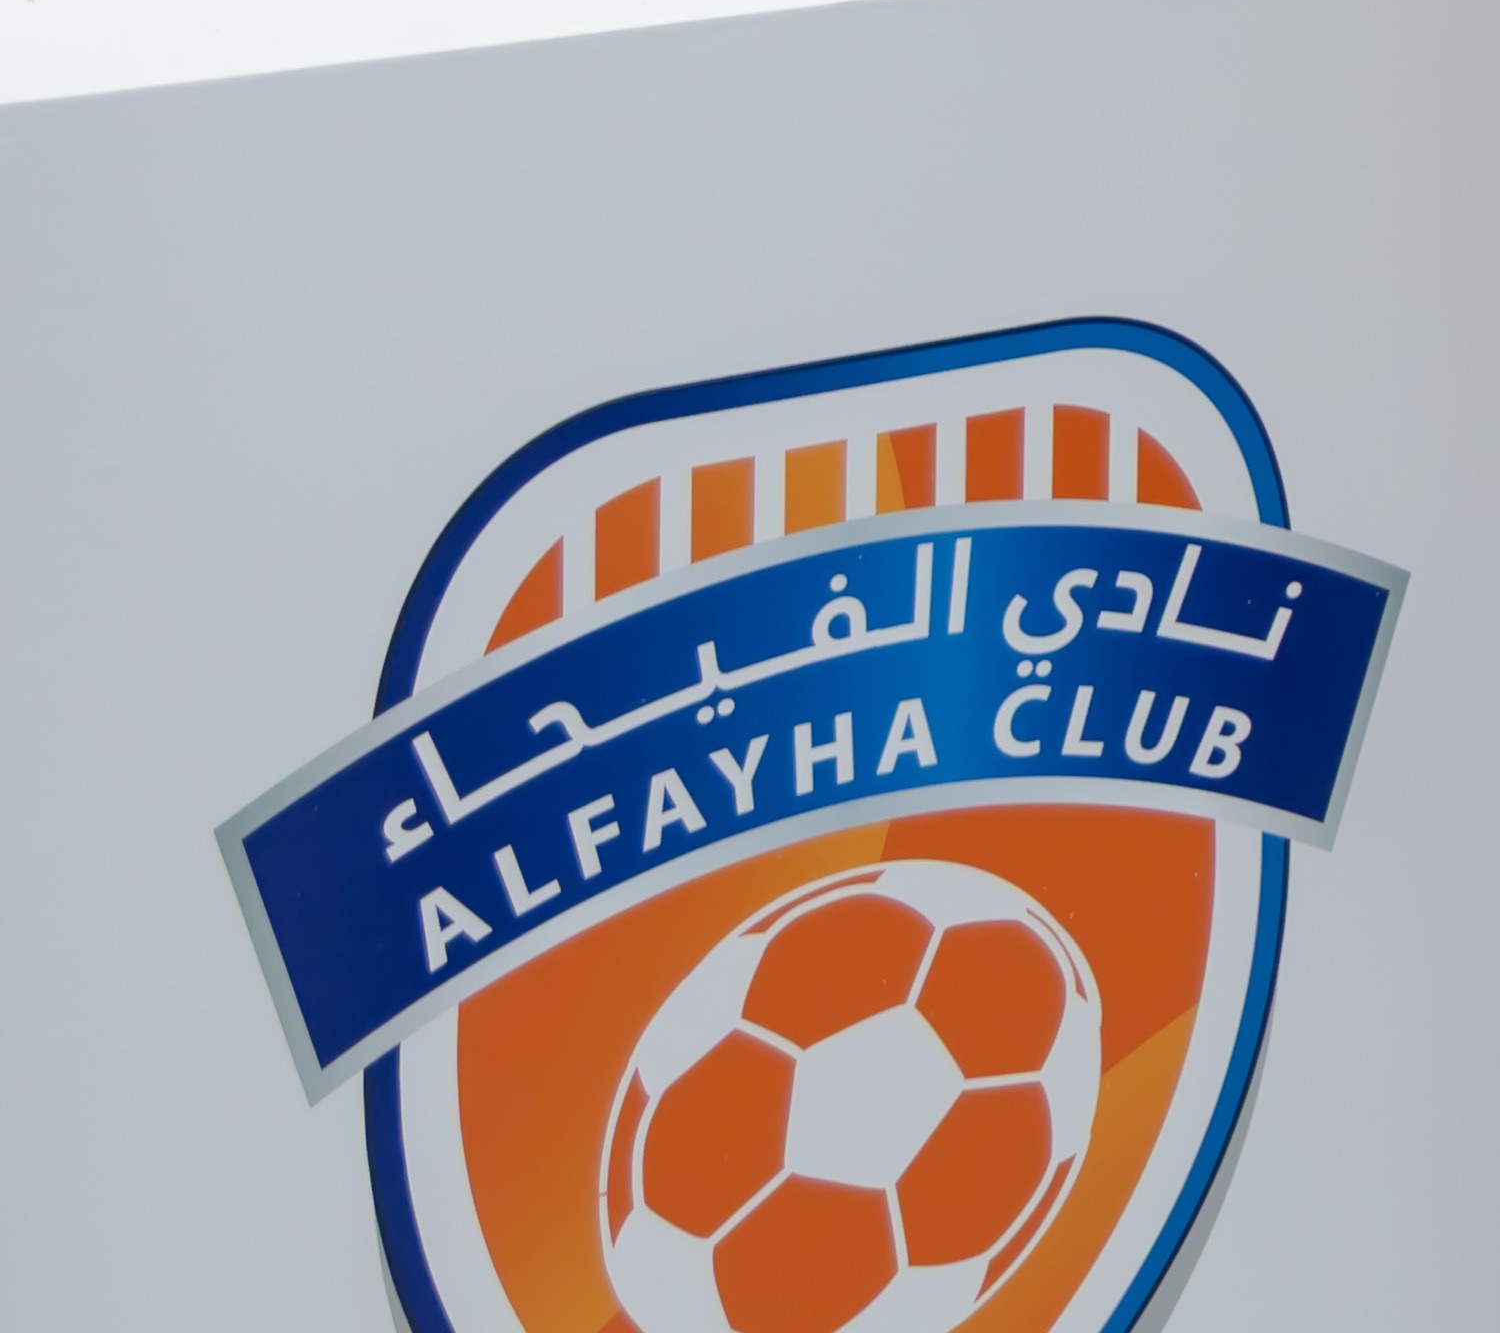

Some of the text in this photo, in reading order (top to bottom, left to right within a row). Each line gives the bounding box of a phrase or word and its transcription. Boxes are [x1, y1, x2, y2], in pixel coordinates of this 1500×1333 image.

[379, 535, 1305, 865] نادي الفيحاء
[415, 682, 1254, 975] ALFAYHA CLUB
